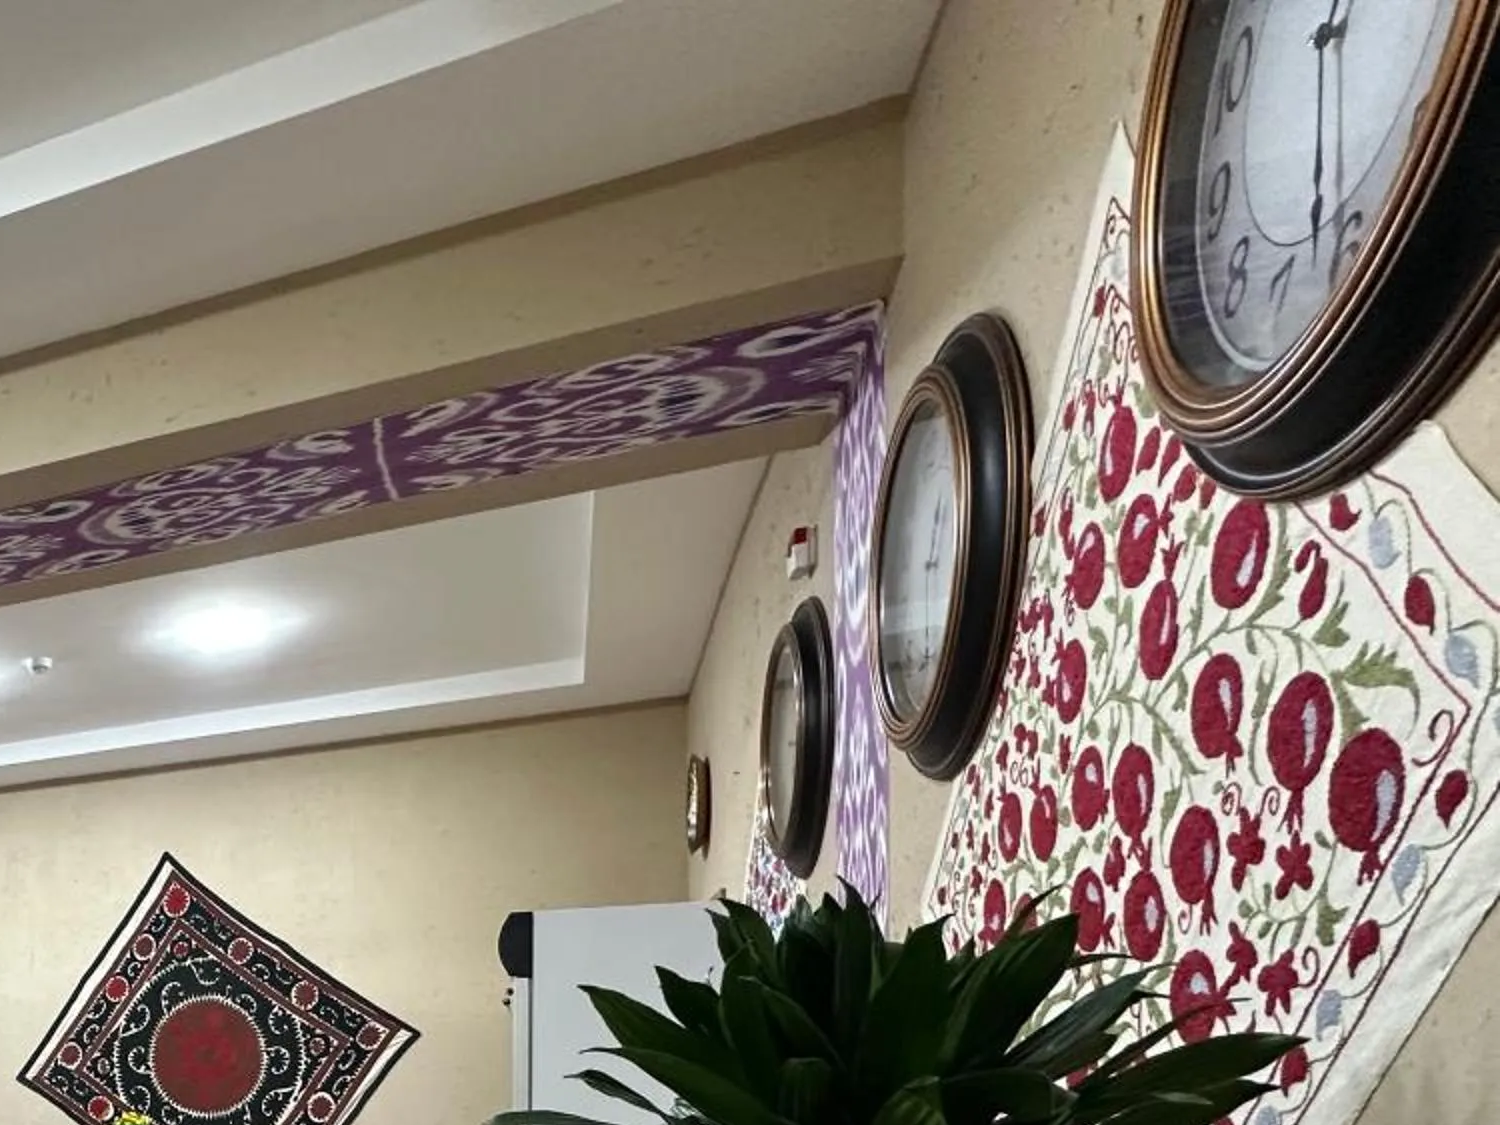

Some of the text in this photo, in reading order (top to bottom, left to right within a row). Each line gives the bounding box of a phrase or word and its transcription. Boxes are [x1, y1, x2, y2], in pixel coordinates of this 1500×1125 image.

[1213, 25, 1252, 137] 10
[1208, 160, 1231, 243] 9
[1223, 235, 1249, 319] 8
[1268, 254, 1296, 315] 7
